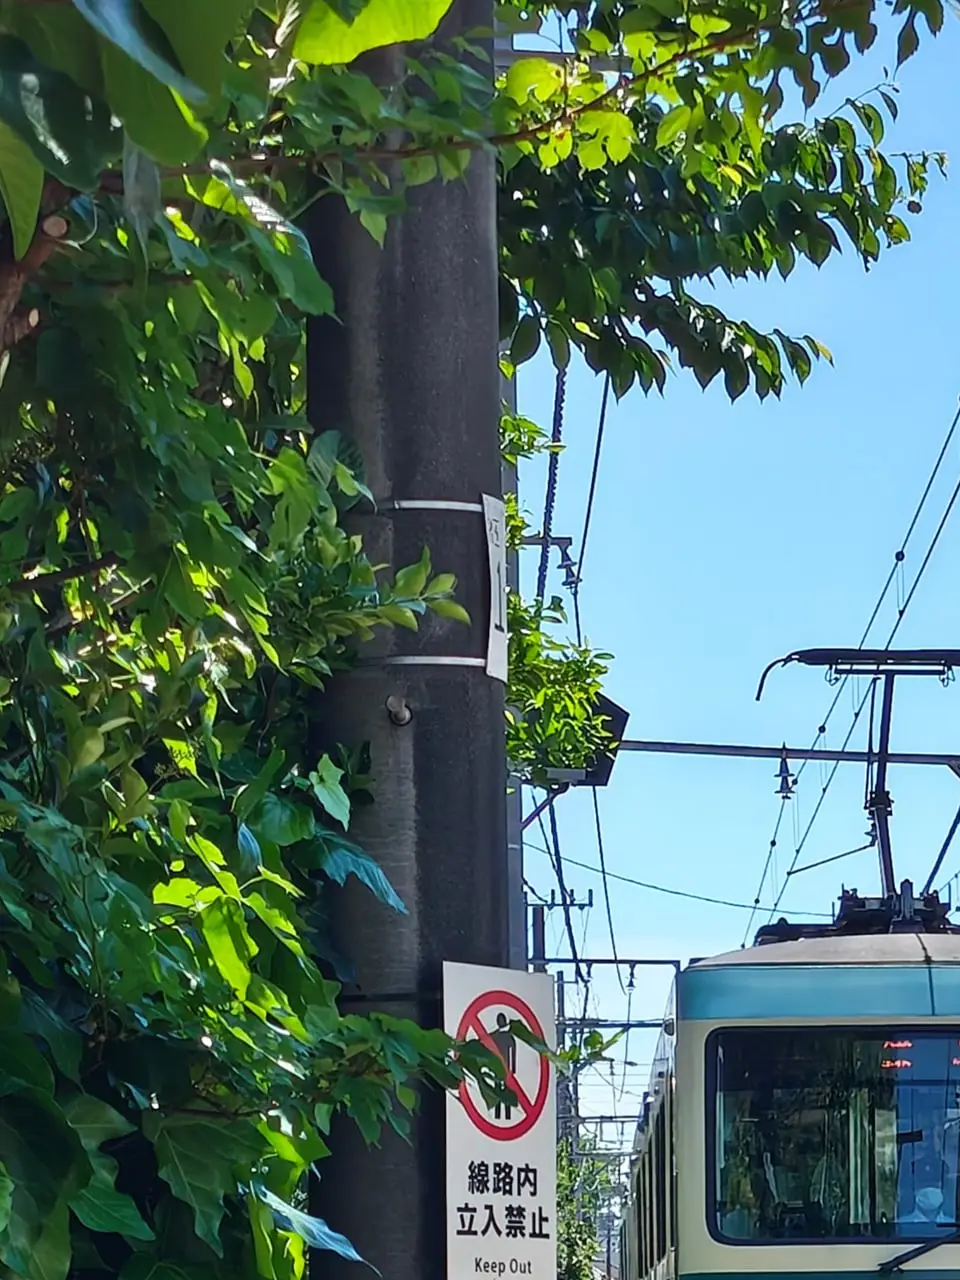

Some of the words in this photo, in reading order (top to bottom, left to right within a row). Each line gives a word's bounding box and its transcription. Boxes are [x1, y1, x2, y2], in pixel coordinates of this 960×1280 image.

[468, 1160, 537, 1197] 線路内
[456, 1202, 550, 1240] 立入禁止
[474, 1257, 506, 1278] Keep
[509, 1258, 532, 1275] Out
